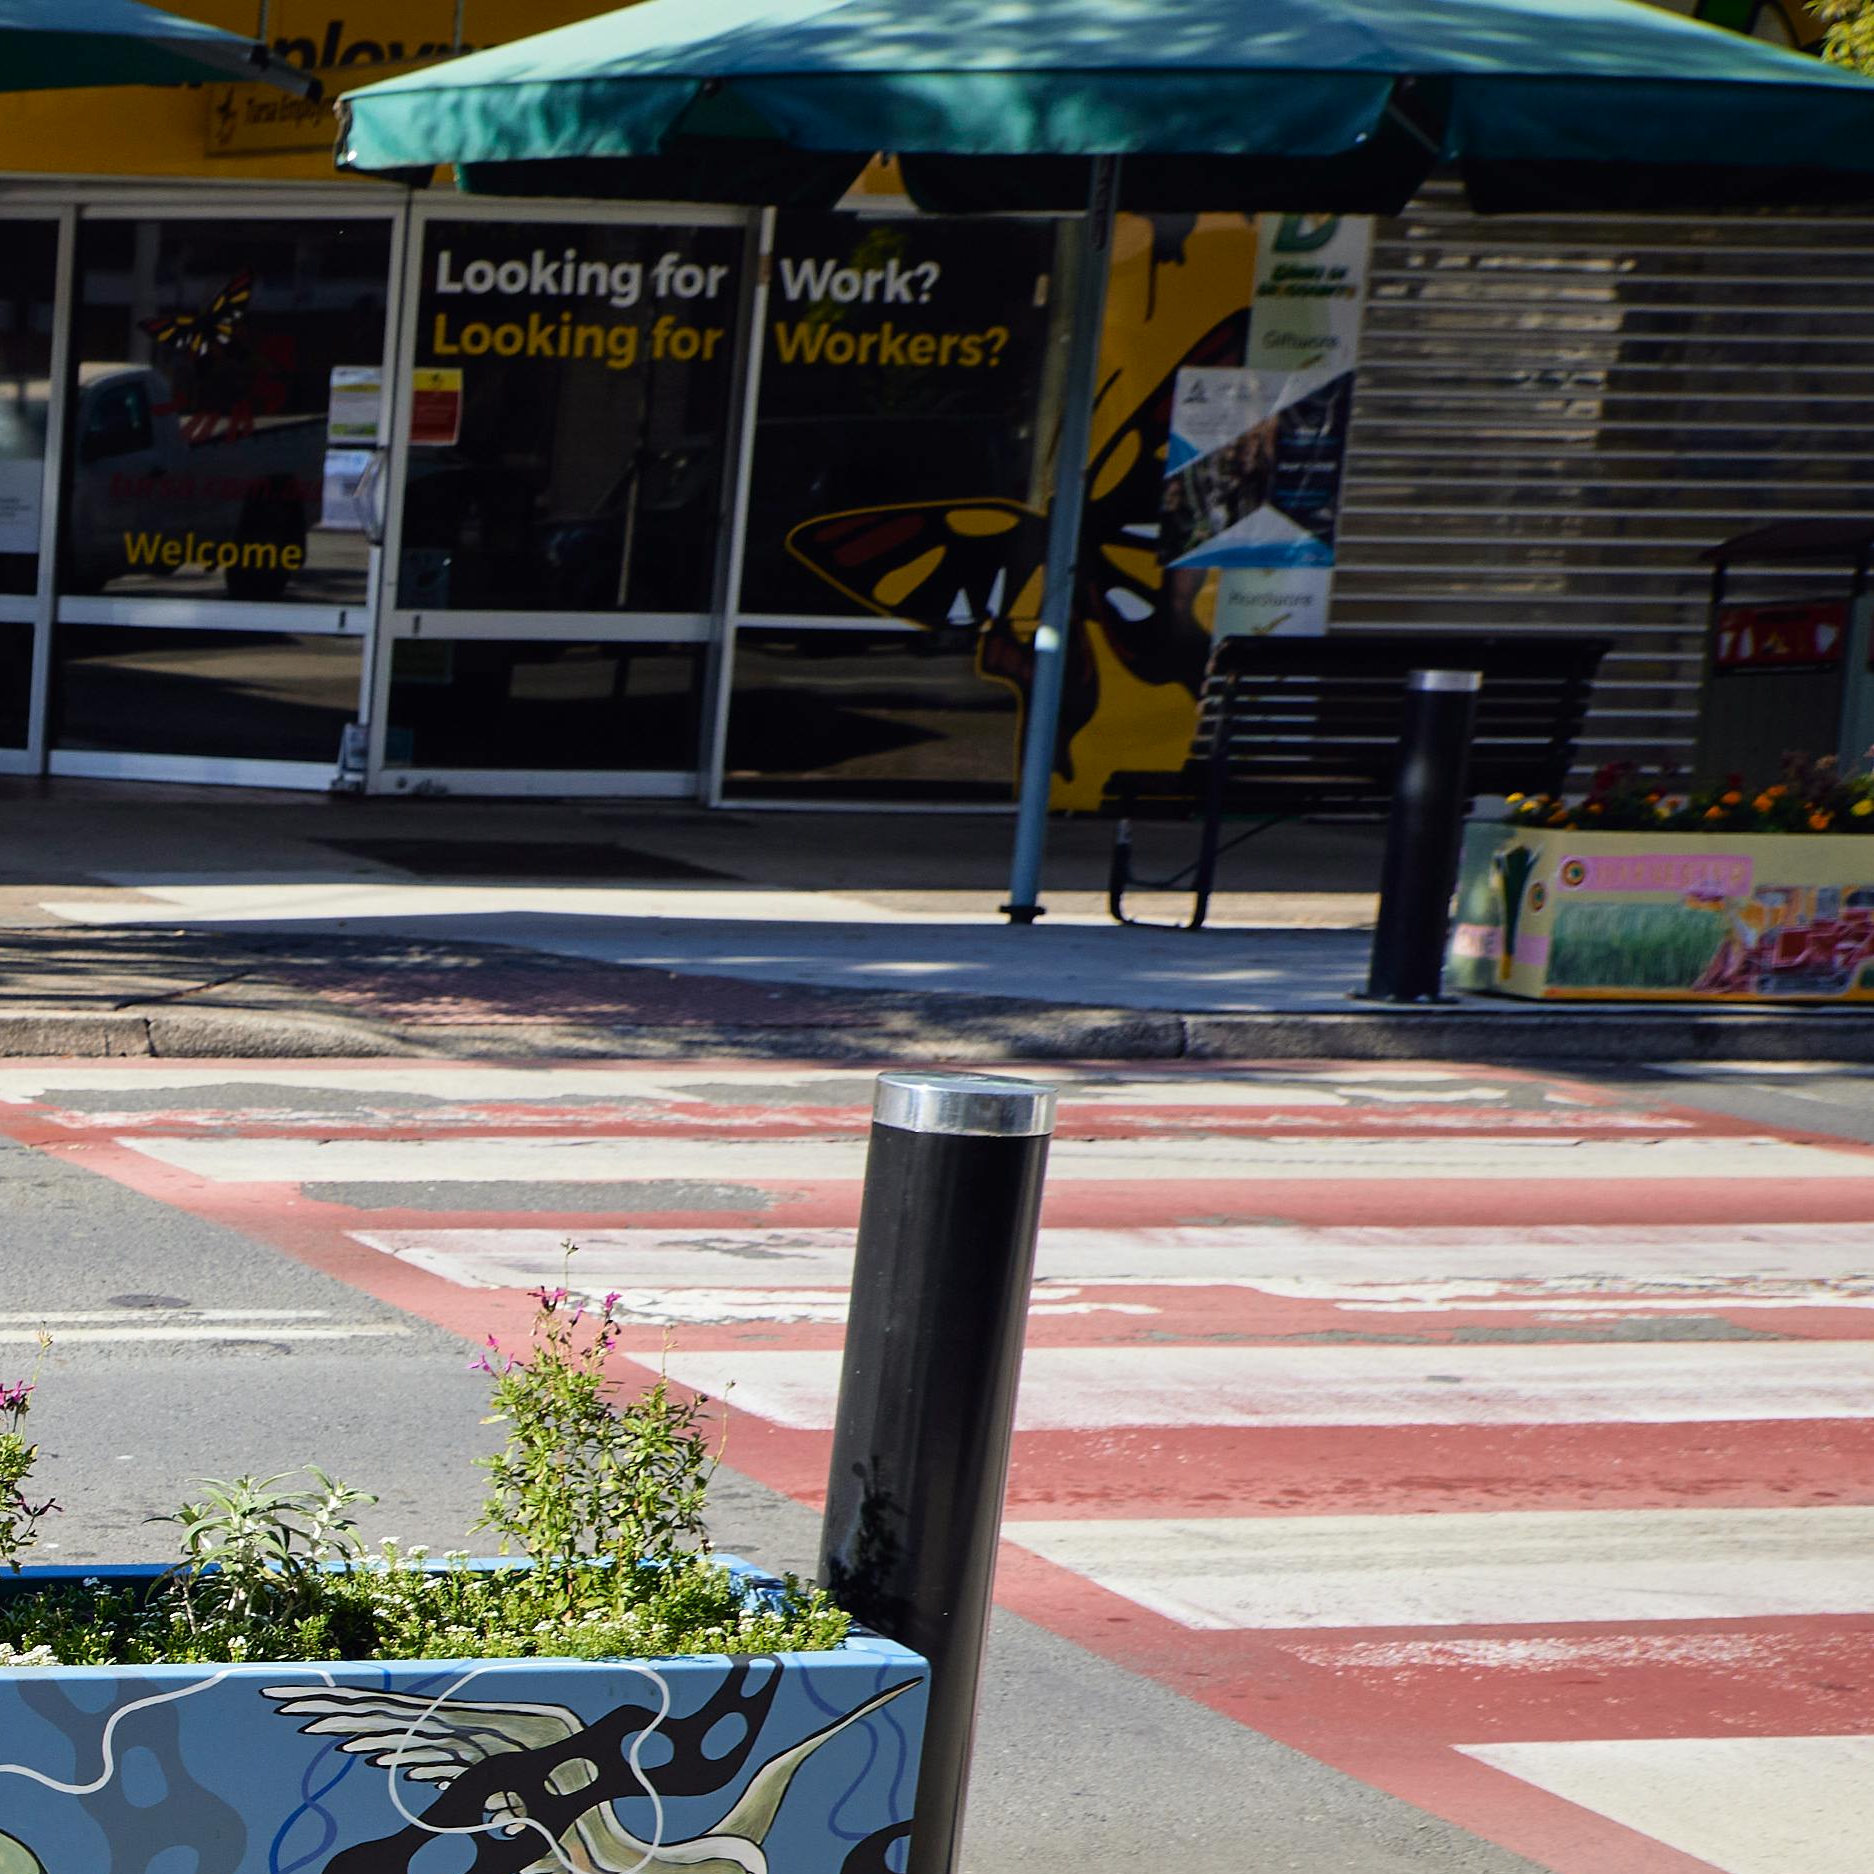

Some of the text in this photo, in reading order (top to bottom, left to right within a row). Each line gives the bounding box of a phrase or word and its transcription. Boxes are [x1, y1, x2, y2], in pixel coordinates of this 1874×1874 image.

[435, 250, 941, 308] Looking for Work?
[433, 313, 1011, 371] Looking for Workers?
[123, 531, 303, 571] Welcome
